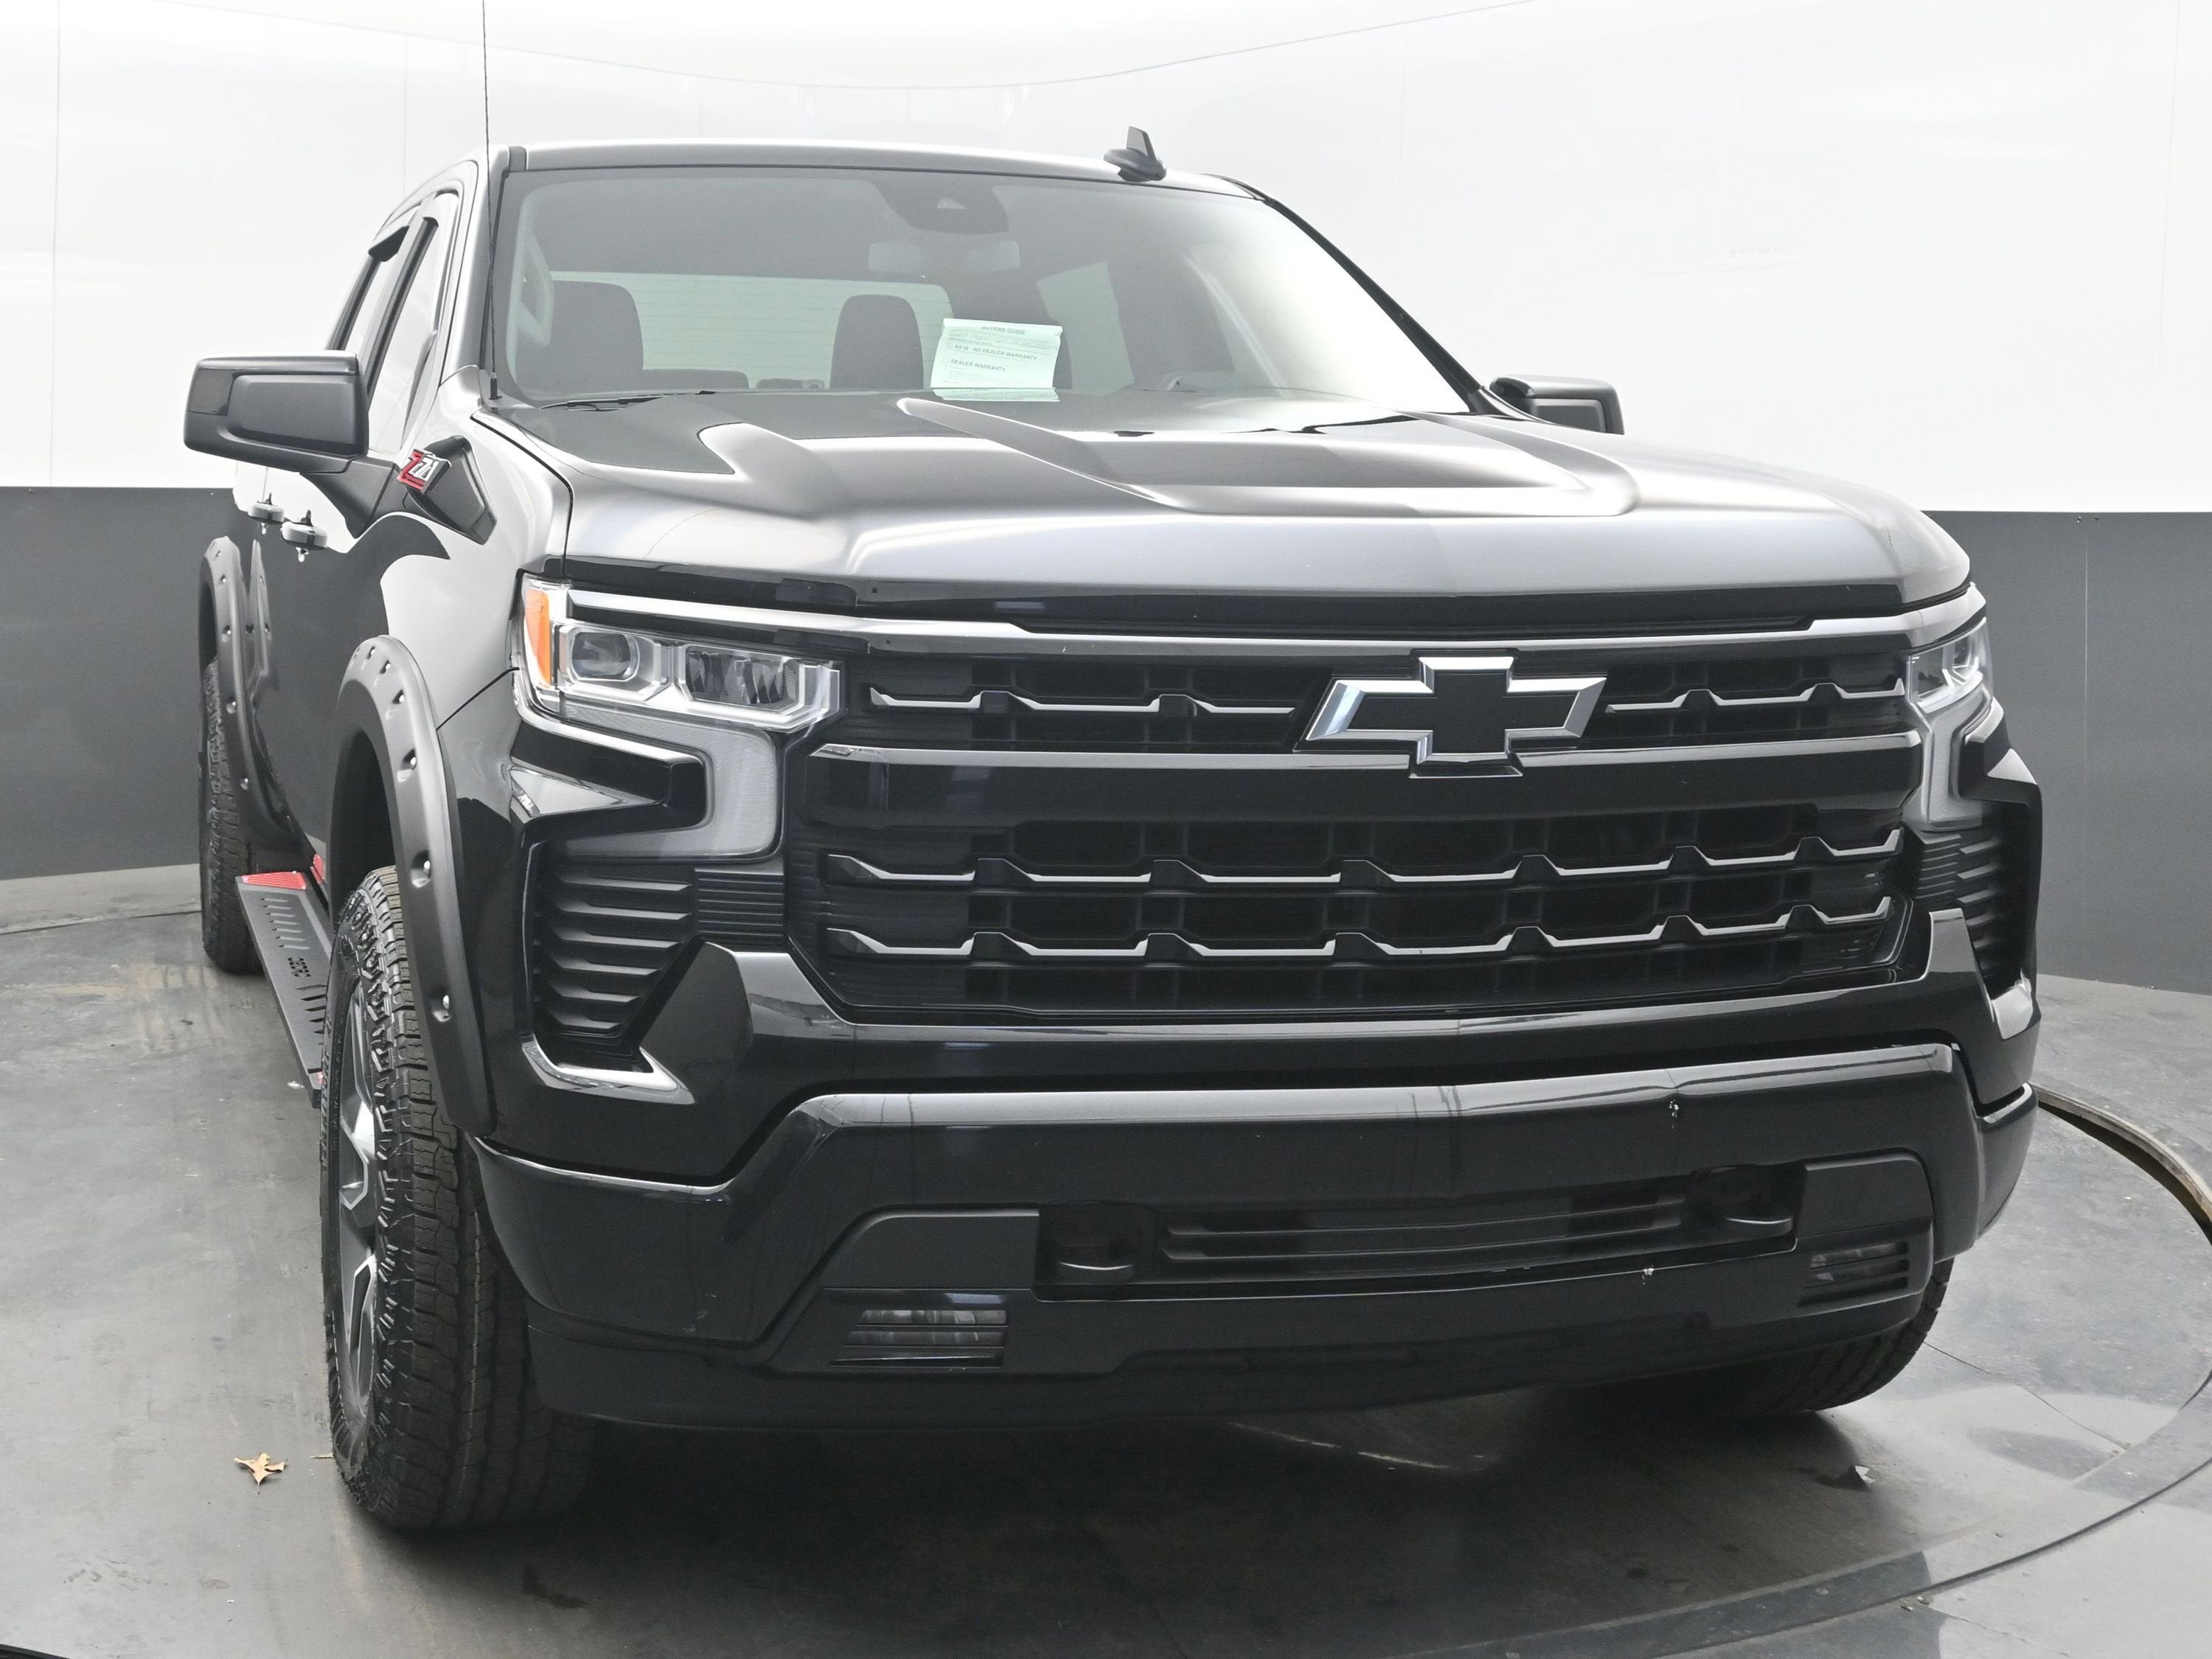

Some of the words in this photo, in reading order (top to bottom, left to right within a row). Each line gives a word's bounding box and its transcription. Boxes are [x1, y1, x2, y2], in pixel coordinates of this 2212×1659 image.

[1006, 352, 1037, 361] WARRANTY
[974, 362, 1006, 372] WARRANTY
[397, 448, 447, 493] Z71
